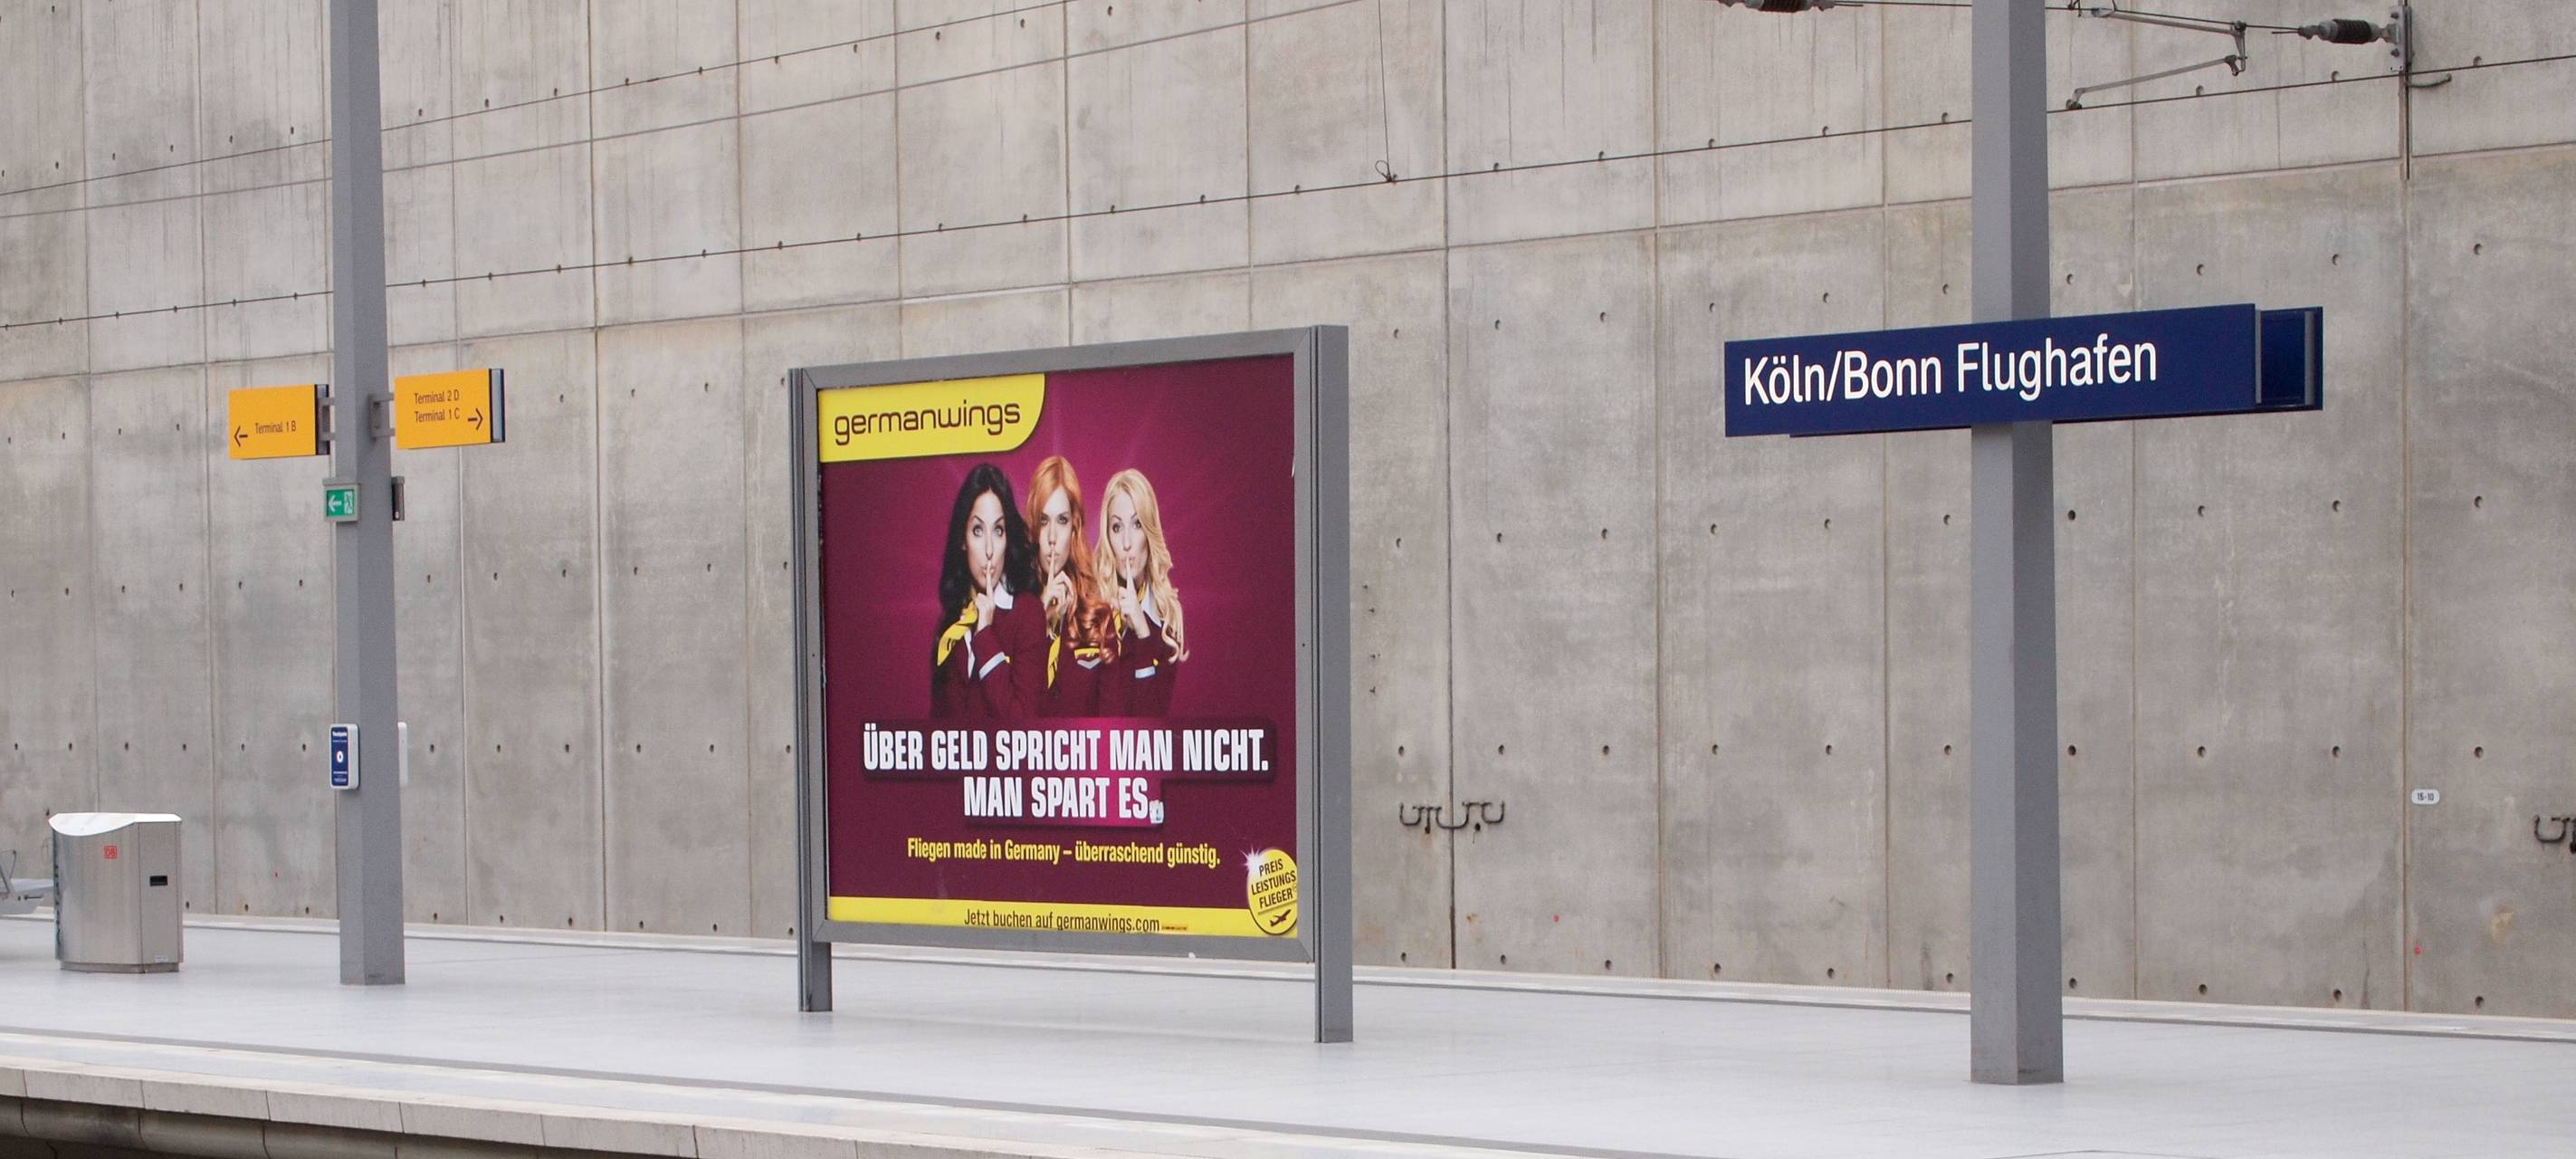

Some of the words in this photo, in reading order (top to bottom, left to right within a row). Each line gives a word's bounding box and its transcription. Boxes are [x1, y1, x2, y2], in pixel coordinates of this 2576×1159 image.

[1744, 350, 1942, 406] Köln/Bonn
[1957, 332, 2157, 402] Flughafen
[414, 390, 444, 405] Terminal
[447, 389, 453, 402] 2
[453, 388, 460, 401] D
[254, 421, 283, 435] Terminal
[291, 419, 297, 432] B
[414, 407, 445, 423] Terminal
[453, 407, 460, 420] C
[835, 398, 1021, 445] germanwings
[863, 723, 924, 771] ÜBER
[930, 730, 988, 771] GELD
[996, 730, 1102, 771] SPRICHT
[1109, 730, 1173, 771] MAN
[1182, 729, 1269, 771] NICHT.
[964, 776, 1023, 817] MAN
[1031, 776, 1111, 819] SPART
[1118, 777, 1165, 824] ES
[907, 837, 951, 863] Fliegen
[954, 838, 987, 859] made
[990, 838, 1002, 859] in
[1005, 838, 1061, 866] Germany
[1075, 840, 1164, 864] überraschend
[1167, 842, 1221, 869] günstig.
[1258, 857, 1283, 877] PREIS
[1251, 869, 1297, 896] LEISTUNGS
[1258, 887, 1293, 909] FLIEGER
[964, 908, 991, 927] Jetzt
[993, 910, 1033, 928] buchen
[1035, 911, 1054, 929] auf
[1056, 913, 1160, 933] germanwings.com
